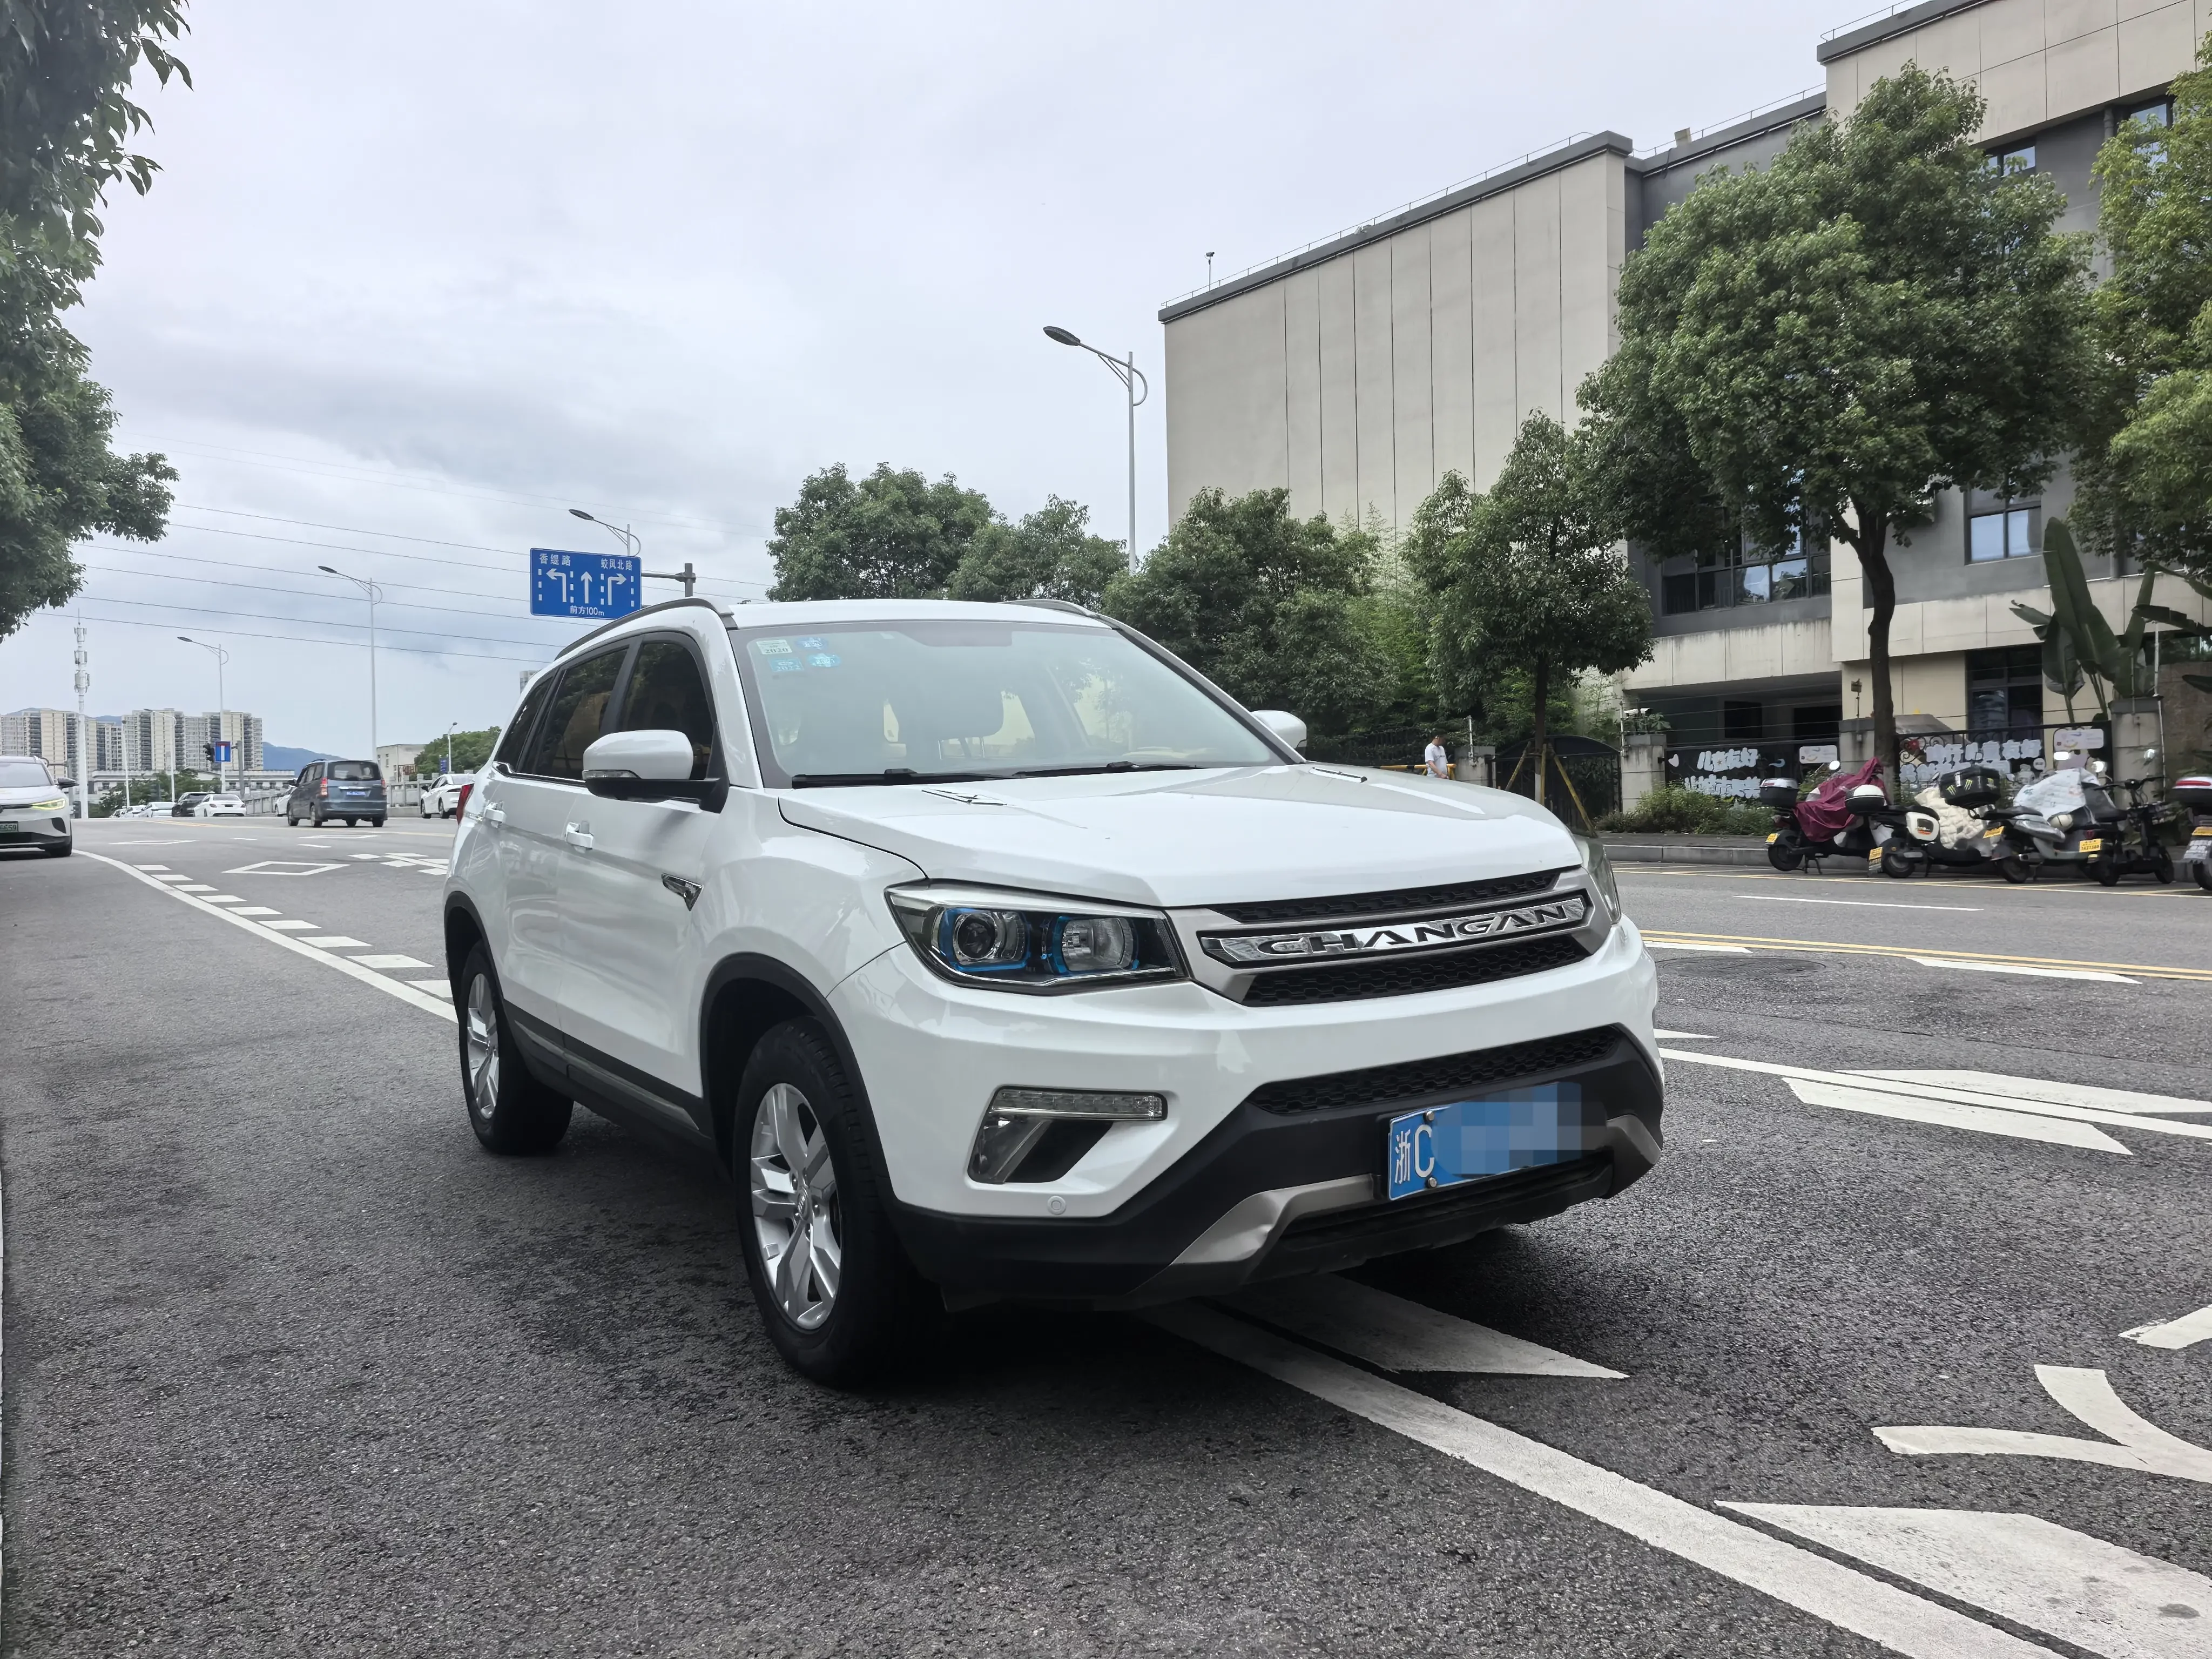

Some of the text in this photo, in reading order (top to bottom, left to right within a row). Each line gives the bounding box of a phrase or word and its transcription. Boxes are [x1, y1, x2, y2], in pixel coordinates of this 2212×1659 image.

[539, 553, 571, 566] 香缇路
[1257, 904, 1568, 955] CHANGAN
